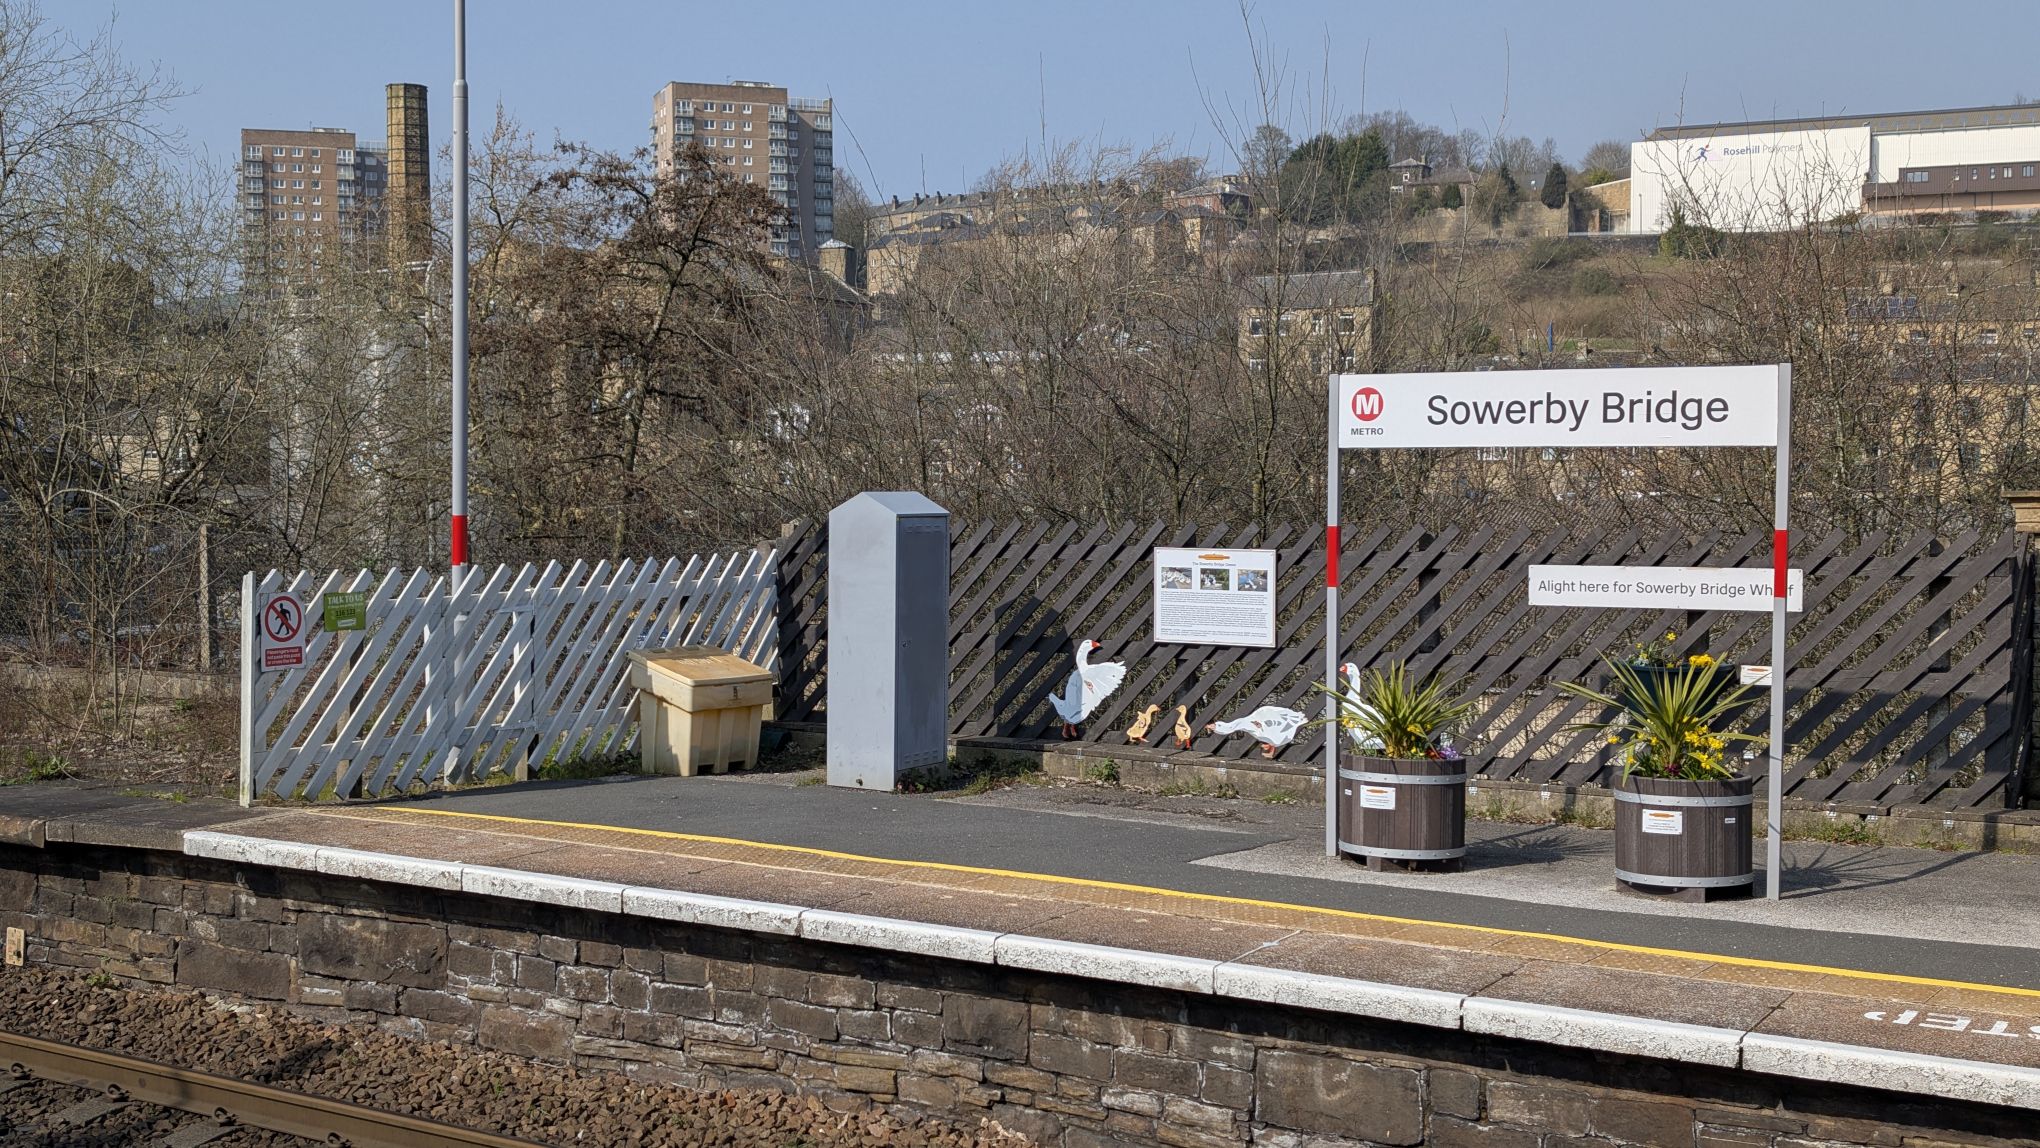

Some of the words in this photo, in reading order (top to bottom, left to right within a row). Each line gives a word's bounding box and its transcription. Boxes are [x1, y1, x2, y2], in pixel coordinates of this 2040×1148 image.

[1723, 145, 1760, 156] Rosehill
[1356, 394, 1378, 415] M
[1427, 390, 1589, 431] Sowerby
[1603, 390, 1729, 430] Bridge
[1538, 580, 1576, 594] Alight
[1580, 581, 1610, 592] here
[1614, 582, 1632, 593] for
[1636, 582, 1696, 596] Sowerby
[1700, 584, 1746, 598] Bridge
[1750, 584, 1794, 596] Whf
[328, 596, 344, 604] TALK
